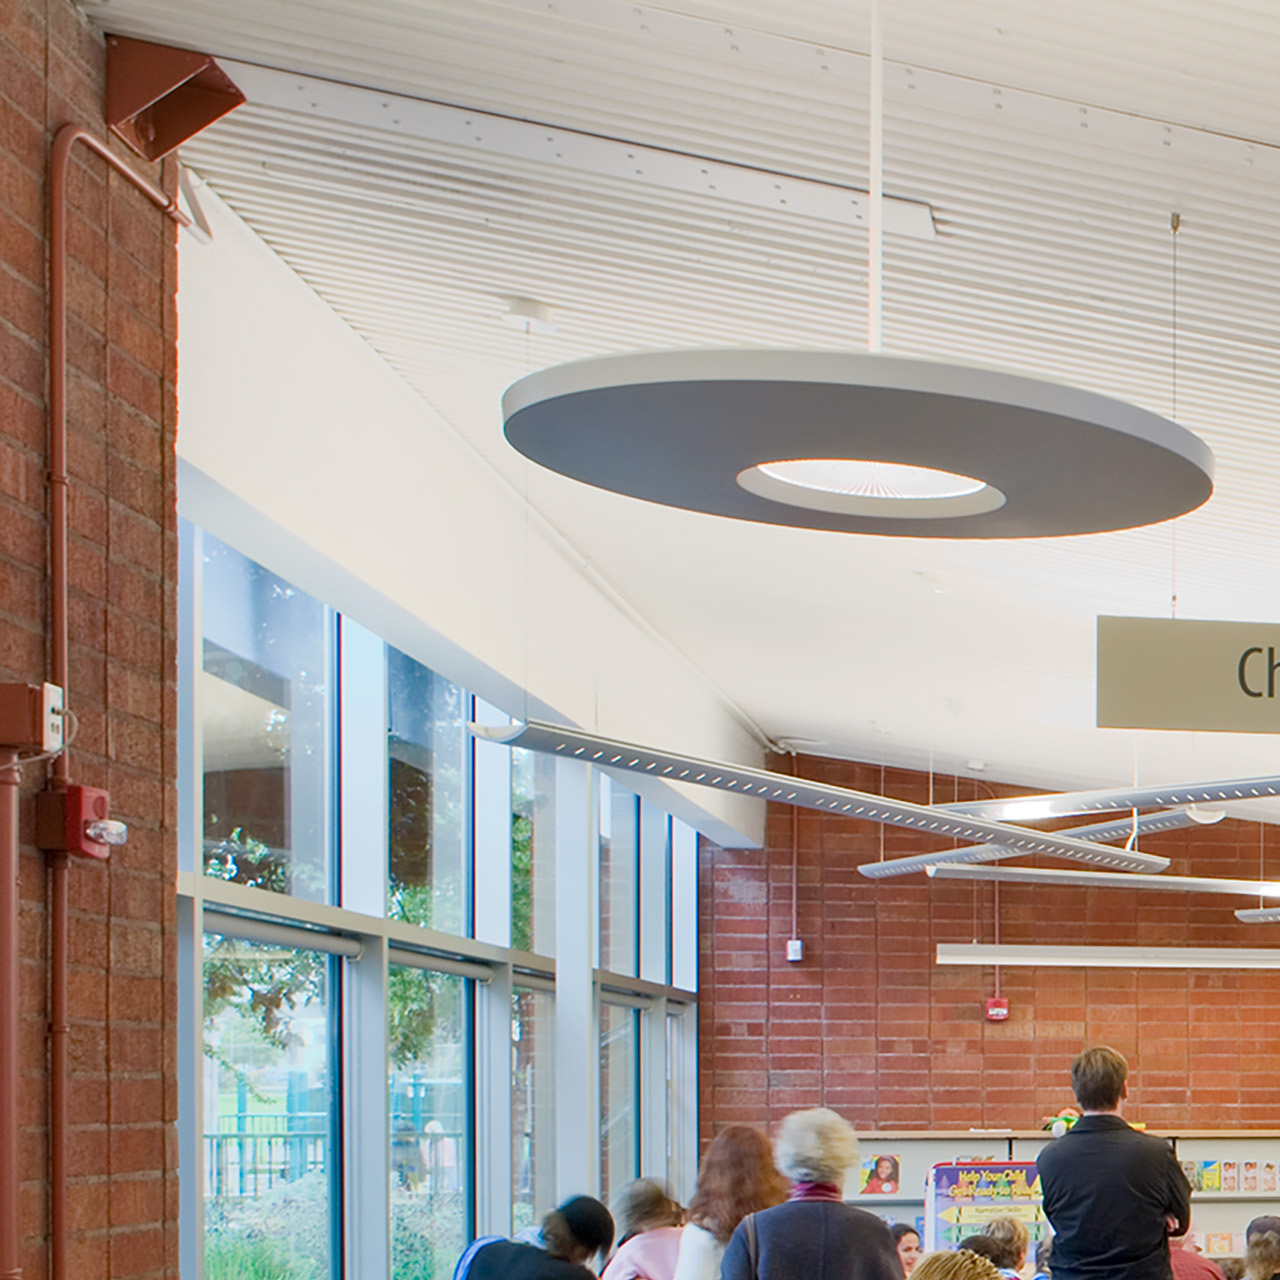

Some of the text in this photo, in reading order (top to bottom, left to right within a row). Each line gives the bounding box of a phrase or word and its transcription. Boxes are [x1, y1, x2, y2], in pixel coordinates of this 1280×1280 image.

[959, 1169, 1027, 1186] Help Your Child
